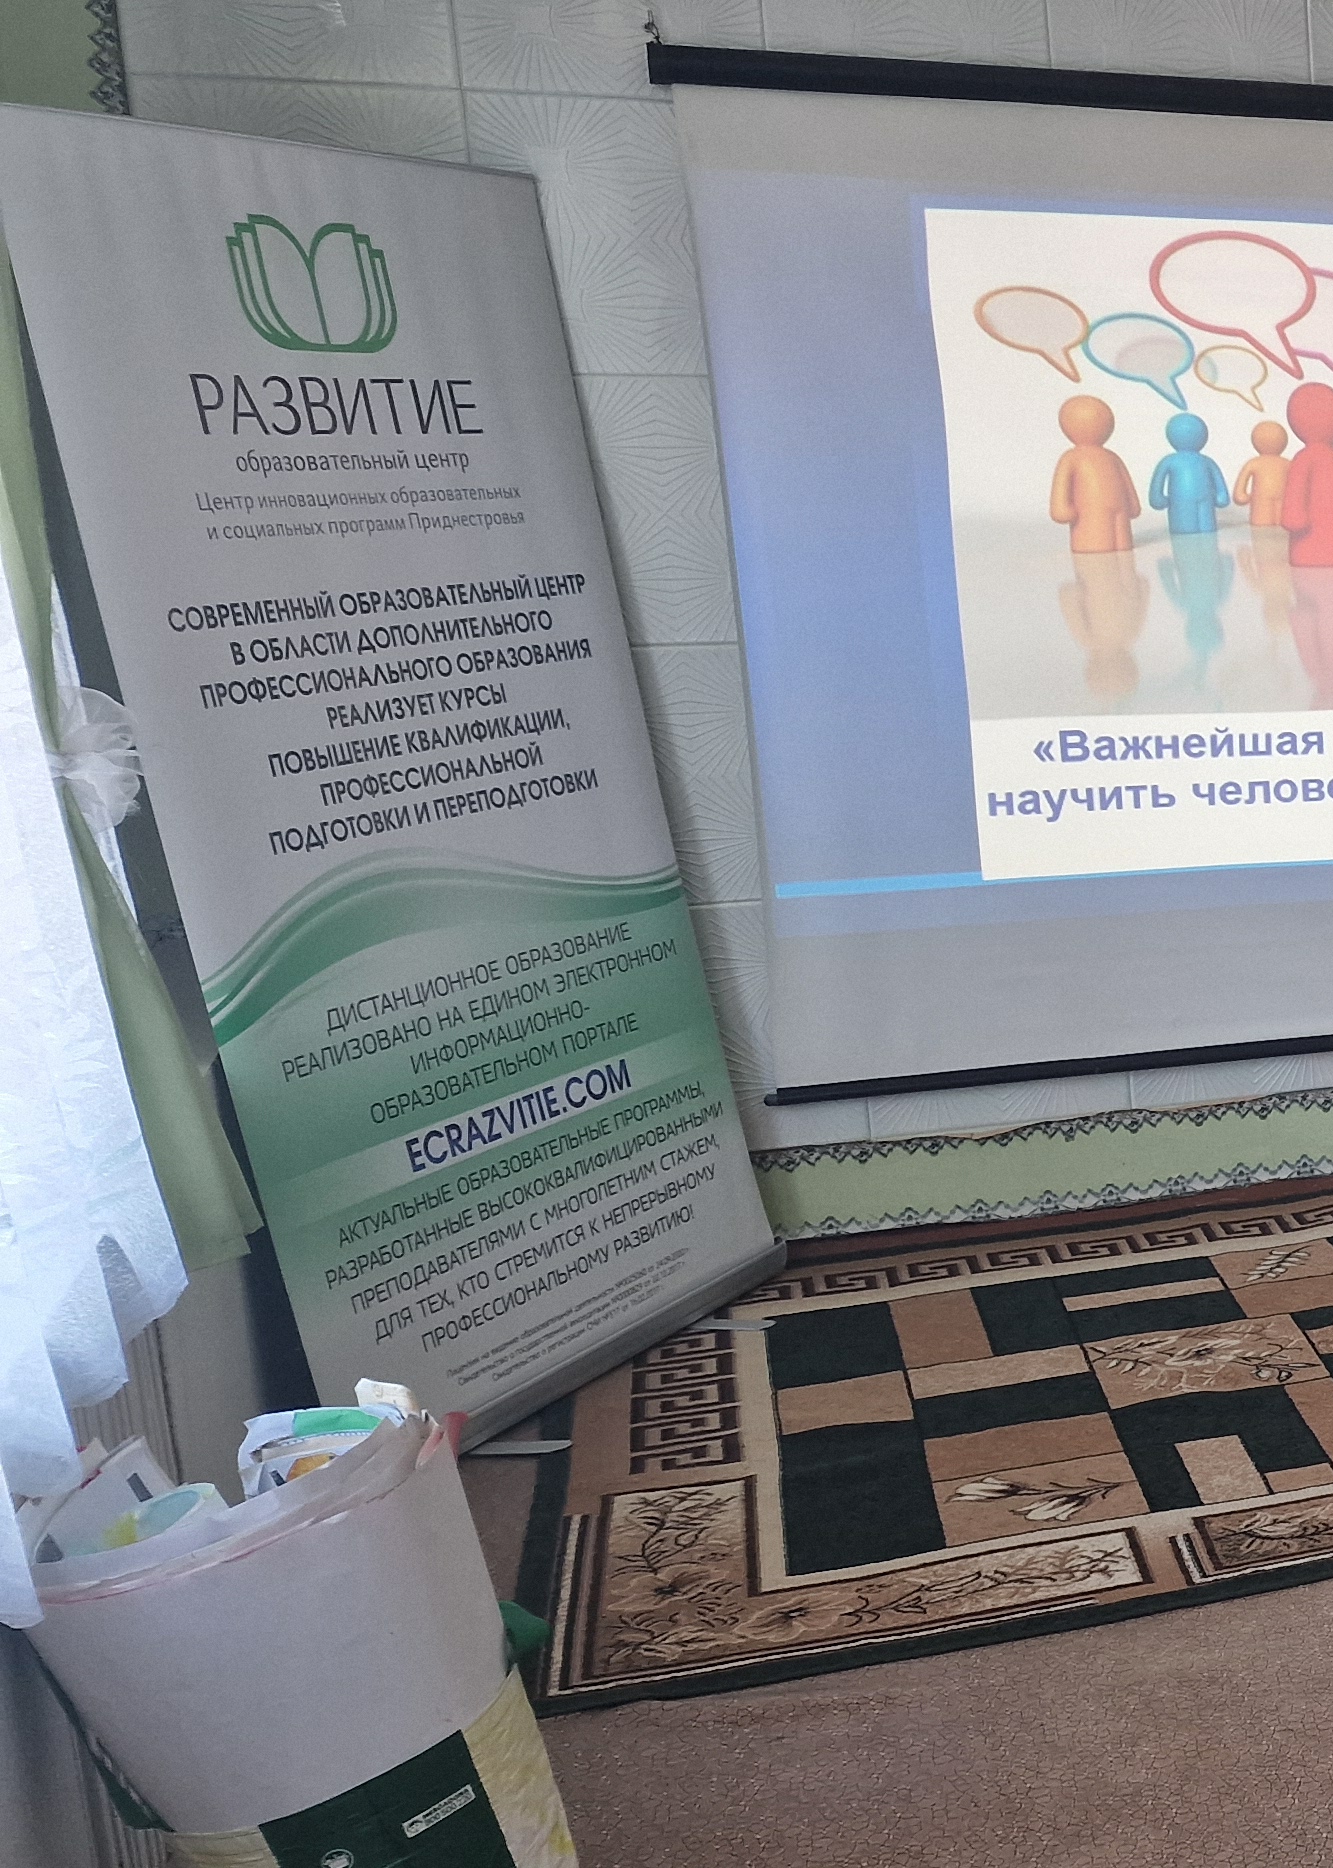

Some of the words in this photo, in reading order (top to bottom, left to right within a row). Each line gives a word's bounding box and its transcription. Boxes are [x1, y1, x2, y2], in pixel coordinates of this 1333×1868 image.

[190, 373, 482, 435] РАЗВИТИЕ
[235, 448, 409, 478] образовательный
[413, 452, 469, 473] центр
[194, 491, 254, 514] Центр
[257, 492, 387, 509] инновационных
[389, 485, 521, 507] образовательных
[205, 525, 219, 540] и
[222, 521, 325, 540] социальных
[327, 517, 406, 538] программ
[407, 511, 524, 533] Приднестровья
[167, 590, 335, 632] СОВРЕМЕННЫЙ
[338, 574, 532, 615] ОБРАЗОВАТЕЛЬНЫЙ
[533, 573, 585, 600] ЦЕНТР
[229, 641, 245, 665] В
[249, 630, 351, 662] ОБЛАСТИ
[357, 609, 552, 654] ДОПОЛНИТЕЛЬНОГО
[199, 655, 452, 708] ПРОФЕССИОНАЛЬНОГО
[456, 638, 591, 674] ОБРАЗОВАНИЯ
[325, 692, 435, 729] РЕАЛИЗУЕТ
[437, 682, 507, 712] КУРСЫ
[267, 733, 402, 777] ПОВЫШЕНИЕ
[404, 708, 569, 753] КВАЛИФИКАЦИИ,
[319, 741, 543, 805] ПРОФЕССИОНАЛЬНОЙ
[1034, 728, 1324, 762] «Важнейшая
[268, 805, 411, 854] ПОДГОТОВКИ
[412, 801, 431, 824] И
[433, 768, 598, 819] ПЕРЕПОДГОТОВКИ
[987, 784, 1175, 822] научить
[281, 1015, 431, 1082] РЕАЛИЗОВАНО
[435, 1005, 465, 1031] НА
[467, 977, 550, 1022] ЕДИНОМ
[553, 938, 676, 993] ЭЛЕКТРОННОМ
[326, 959, 501, 1036] ДИСТАНЦИОННОЕ
[505, 921, 631, 974] ОБРАЗОВАНИЕ
[370, 1040, 557, 1123] ОБРАЗОВАТЕЛЬНОМ
[561, 1012, 639, 1054] ПОРТАЛЕ
[409, 999, 589, 1074] ИНФОРМАЦИОННО-
[405, 1059, 630, 1171] ECRAZVITIE.COM
[325, 1208, 474, 1289] РАЗРАБОТАННЫЕ
[477, 1101, 722, 1220] ВЫСОКОКВАЛИФИЦИРОВАННЫМИ
[339, 1182, 454, 1247] АКТУАЛЬНЫЕ
[456, 1117, 611, 1195] ОБРАЗОВАТЕЛЬНЫЕ
[612, 1080, 704, 1130] ПРОГРАММЫ,
[350, 1219, 525, 1313] ПРЕПОДАВАТЕЛЯМИ
[528, 1211, 542, 1231] С
[543, 1160, 657, 1224] МНОГОЛЕТНИМ
[659, 1133, 719, 1171] СТАЖЕМ,
[375, 1305, 413, 1344] ДЛЯ
[415, 1288, 454, 1317] ТЕХ,
[456, 1270, 490, 1300] КТО
[494, 1224, 585, 1281] СТРЕМИТСЯ
[587, 1217, 600, 1236] К
[601, 1163, 714, 1229] НЕПРЕРЫВНОМУ
[421, 1245, 608, 1351] ПРОФЕССИОНАЛЬНОМУ
[613, 1203, 694, 1255] РАЗВИТИЮ!
